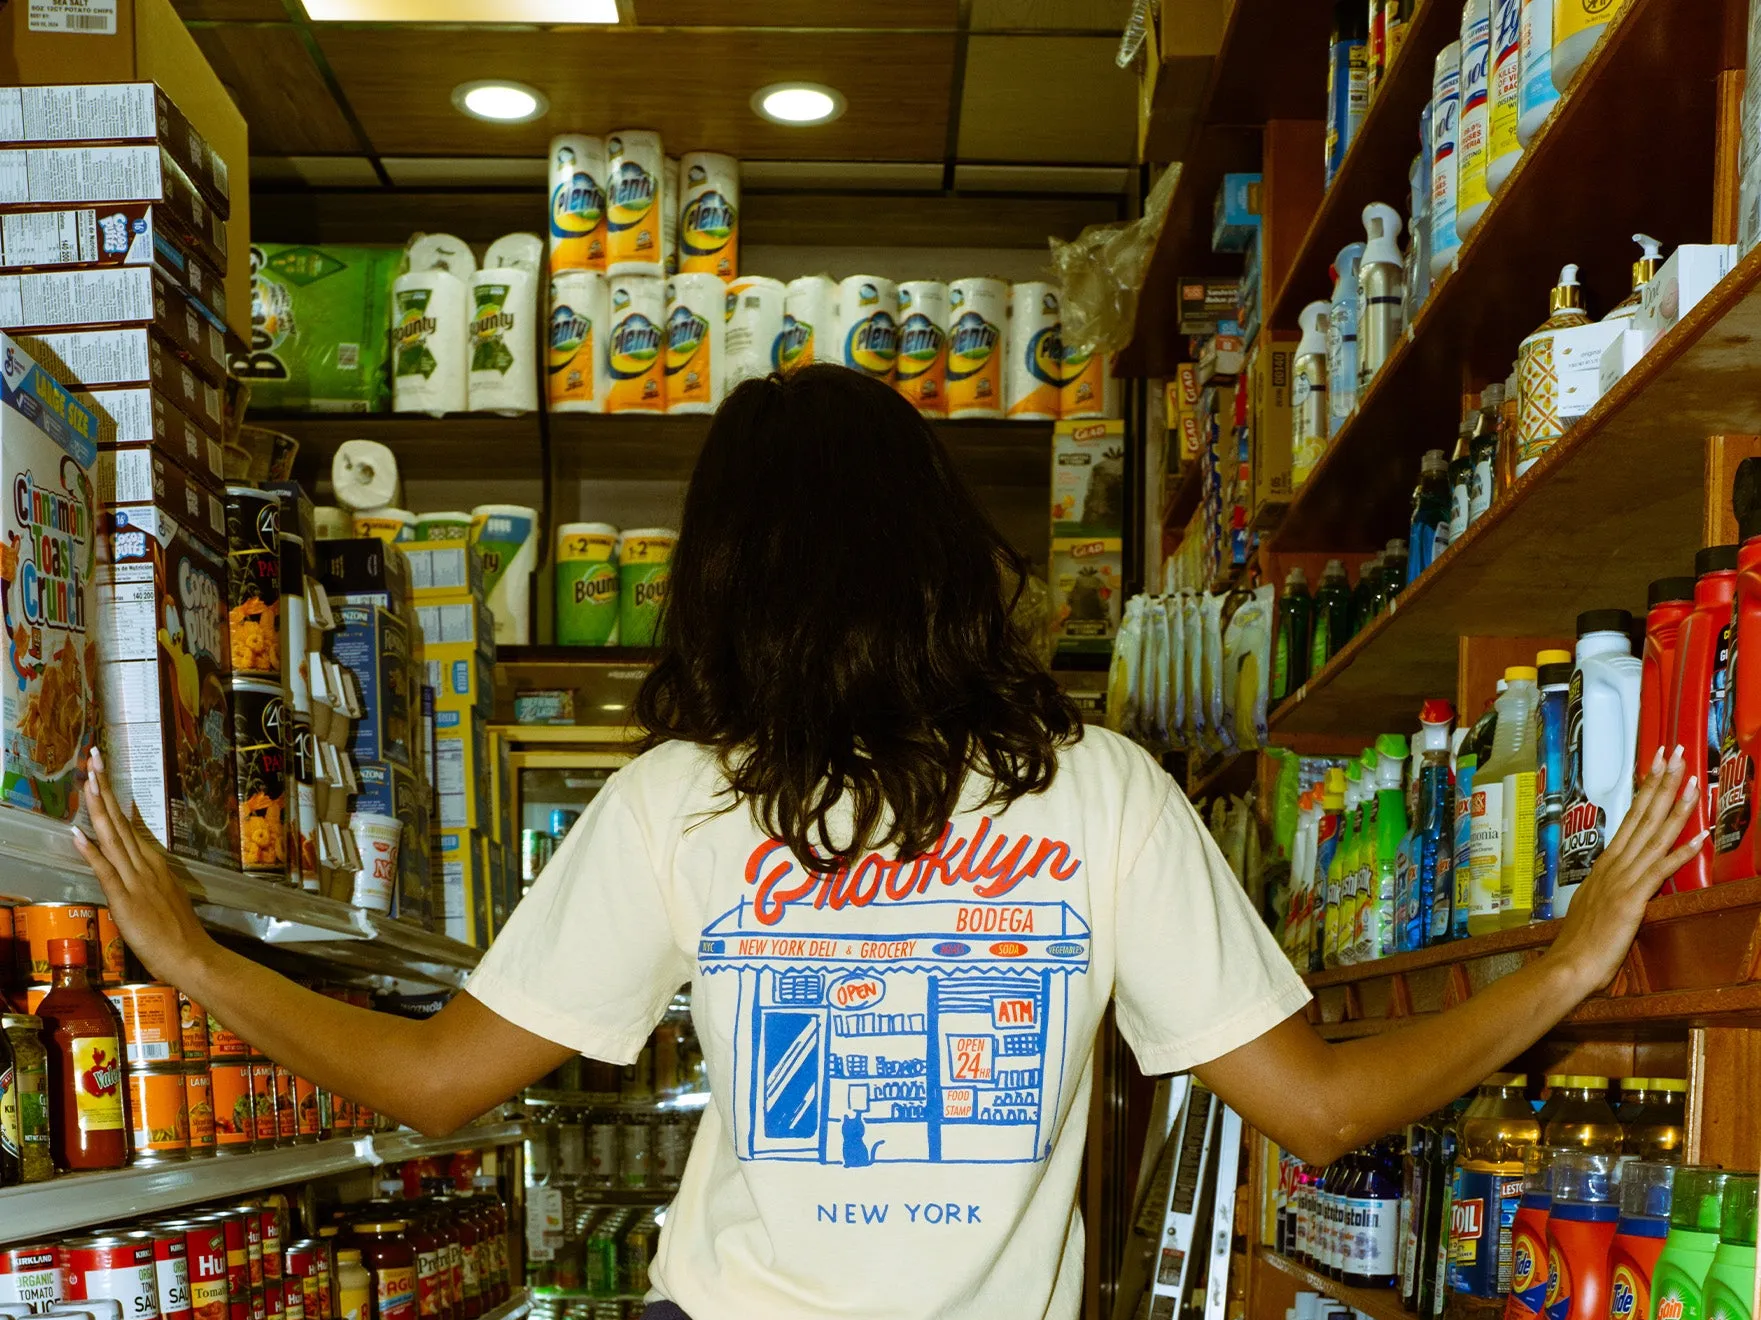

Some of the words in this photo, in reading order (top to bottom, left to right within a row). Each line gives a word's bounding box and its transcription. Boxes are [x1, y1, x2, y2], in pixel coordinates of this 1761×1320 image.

[559, 186, 603, 213] Plent
[393, 315, 437, 343] ounty
[470, 311, 514, 337] ounty
[857, 327, 898, 353] Plent
[1182, 370, 1198, 404] GLAD
[35, 368, 66, 420] LARGE
[67, 400, 89, 439] SIZE
[1075, 427, 1106, 440] GLAD
[1186, 419, 1200, 451] GLAD
[16, 475, 85, 538] Cinnamon
[32, 524, 77, 581] Toast
[1071, 543, 1104, 557] GLAD
[24, 562, 85, 628] Crunch
[132, 592, 142, 600] 140
[143, 591, 154, 600] 200
[574, 577, 617, 605] Boun
[1729, 788, 1746, 807] GEL
[1562, 829, 1599, 855] LIQUID
[745, 816, 1082, 926] Brooklyn
[68, 909, 79, 918] LA
[955, 907, 1034, 934] BODEGA
[702, 941, 715, 953] NYC
[738, 939, 768, 956] NEW
[771, 939, 806, 957] YORK
[808, 941, 837, 958] DELI
[845, 945, 853, 956] &
[860, 940, 917, 959] GROCERY
[999, 944, 1020, 955] SODA
[836, 981, 878, 1006] OPEN
[997, 1000, 1034, 1024] ATM
[957, 1038, 985, 1053] OPEN
[955, 1052, 980, 1080] 24
[979, 1067, 991, 1078] HR
[946, 1090, 970, 1102] FOOD
[945, 1105, 972, 1118] STAMP
[817, 1203, 890, 1225] NEW
[903, 1203, 982, 1225] YORK
[14, 1253, 53, 1266] KIRKLAND
[1514, 1250, 1532, 1276] Tide
[17, 1272, 54, 1288] ORGANIC
[19, 1287, 54, 1301] TOMATO
[1612, 1282, 1634, 1313] Tide
